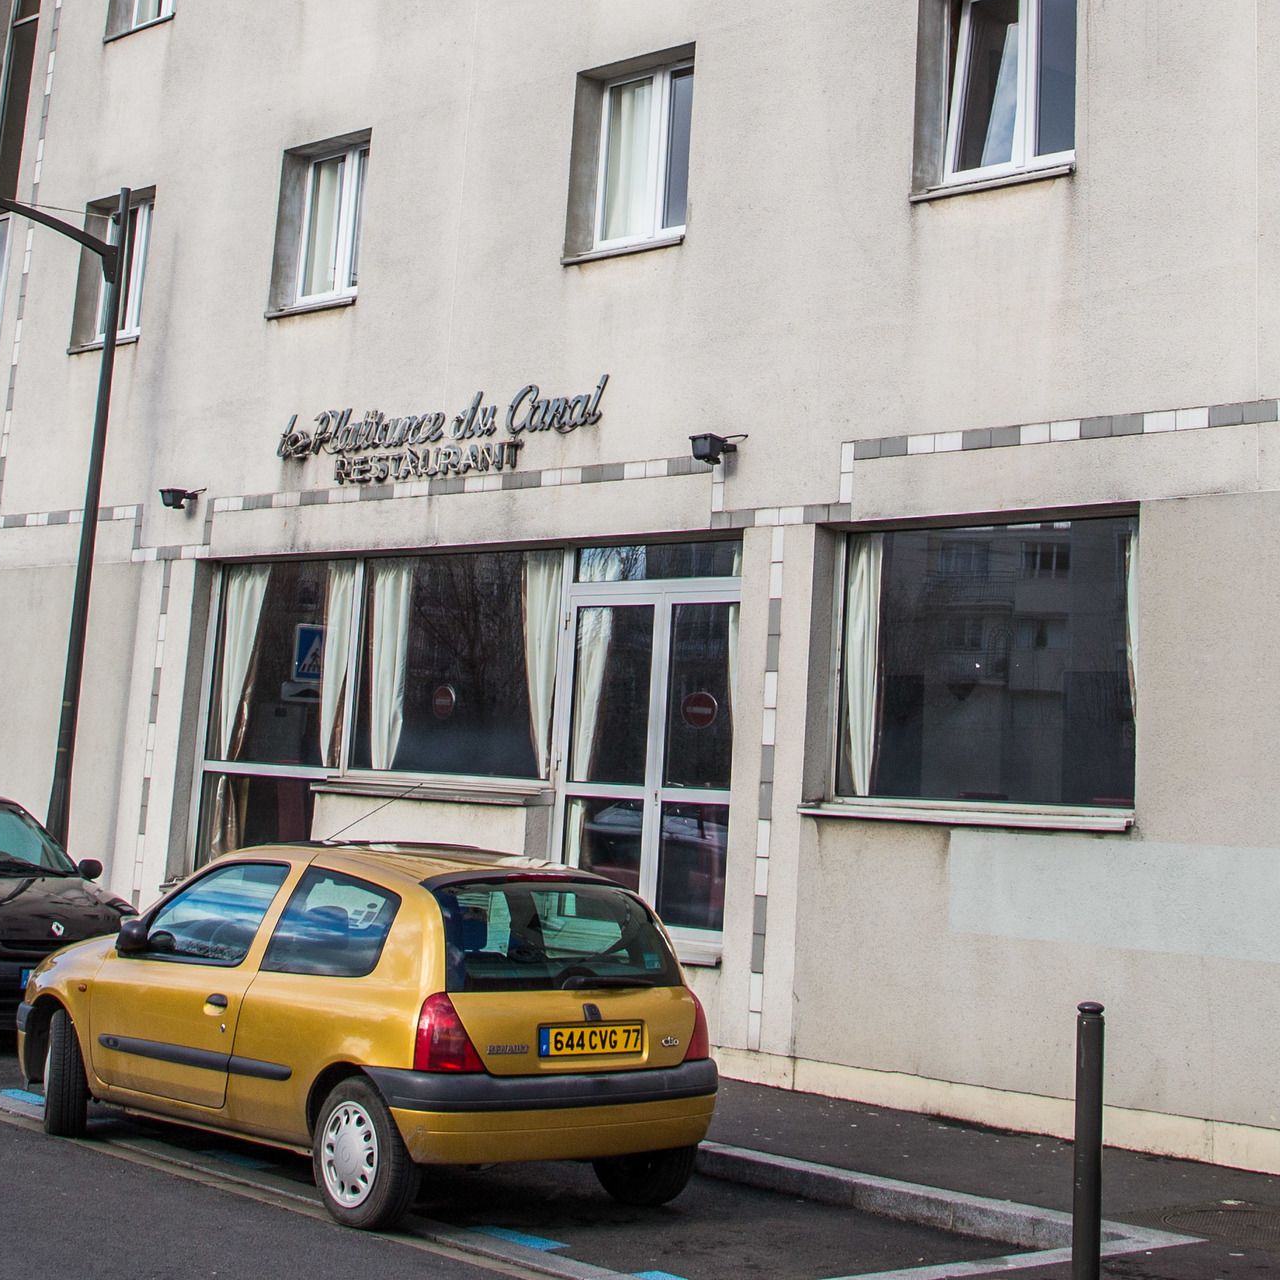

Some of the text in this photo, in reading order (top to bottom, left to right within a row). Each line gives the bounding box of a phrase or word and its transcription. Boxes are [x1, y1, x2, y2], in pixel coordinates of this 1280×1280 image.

[450, 391, 498, 440] du
[505, 373, 610, 434] Canal
[333, 438, 524, 484] RESTAURANT
[553, 1031, 585, 1051] 644
[589, 1029, 618, 1050] CVG
[622, 1028, 641, 1048] 77
